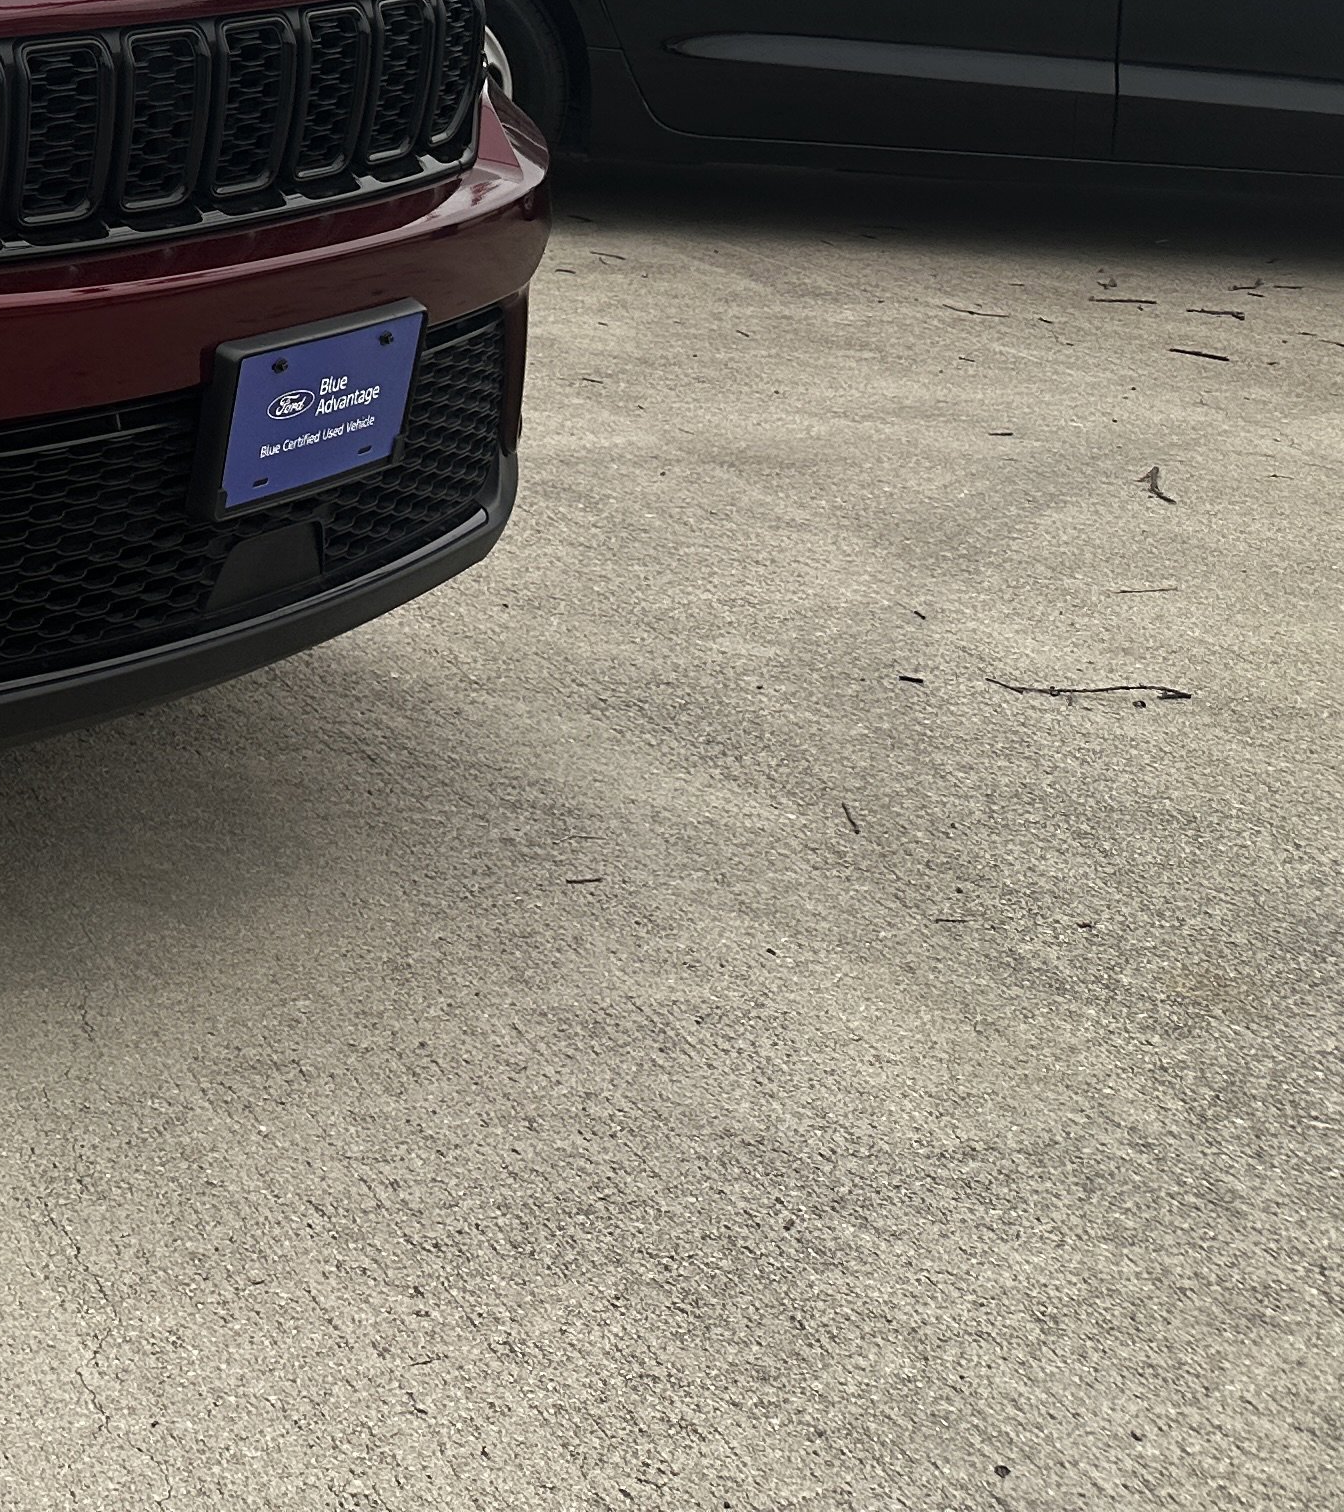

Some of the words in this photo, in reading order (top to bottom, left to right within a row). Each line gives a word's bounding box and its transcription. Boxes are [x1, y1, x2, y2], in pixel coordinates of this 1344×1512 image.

[319, 376, 348, 395] Blue
[275, 394, 307, 416] Ford
[315, 385, 380, 416] Advantage
[260, 444, 281, 458] Blue
[282, 430, 321, 451] Certified
[322, 423, 344, 440] Used
[347, 415, 375, 433] Vehicle
